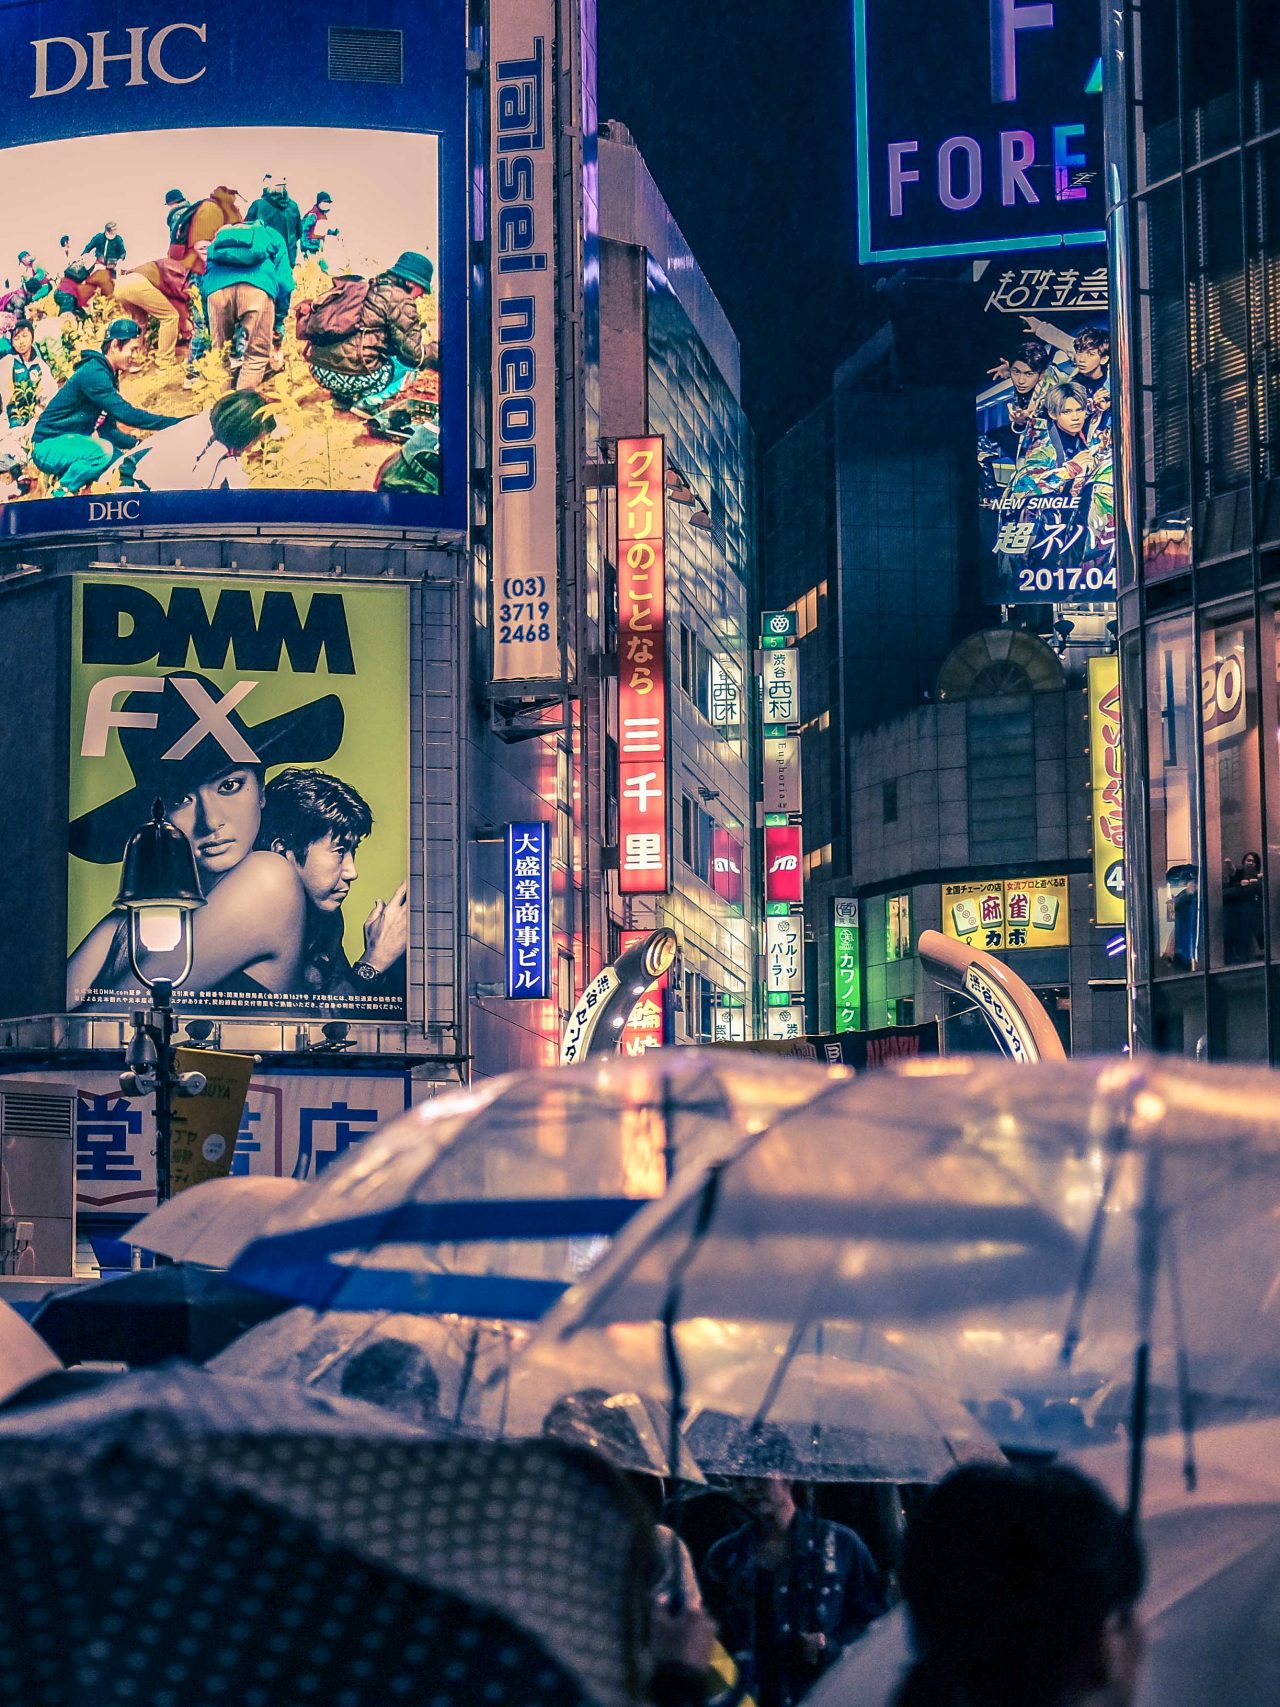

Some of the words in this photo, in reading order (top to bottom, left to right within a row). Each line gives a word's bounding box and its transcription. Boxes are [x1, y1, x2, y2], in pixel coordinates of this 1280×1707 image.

[30, 23, 207, 99] DHC
[496, 36, 547, 274] Taisei
[498, 296, 536, 494] neon
[88, 500, 140, 521] DHC
[991, 498, 1024, 511] NEW
[1027, 496, 1081, 510] SINGLE
[503, 576, 546, 598] (03)
[626, 450, 656, 695] クスリのことなら
[82, 583, 356, 674] DMM
[499, 602, 550, 622] 3719
[499, 624, 550, 644] 2468
[80, 675, 263, 764] FX
[622, 717, 662, 870] 三千里
[776, 743, 788, 799] Euphoria
[770, 855, 798, 874] JTB
[515, 833, 541, 989] 大盛堂商事ビル
[945, 882, 1002, 896] 全国チェーンの店
[981, 893, 1028, 921] 麻雀
[771, 942, 783, 987] パーラー
[785, 933, 798, 979] フルーツ
